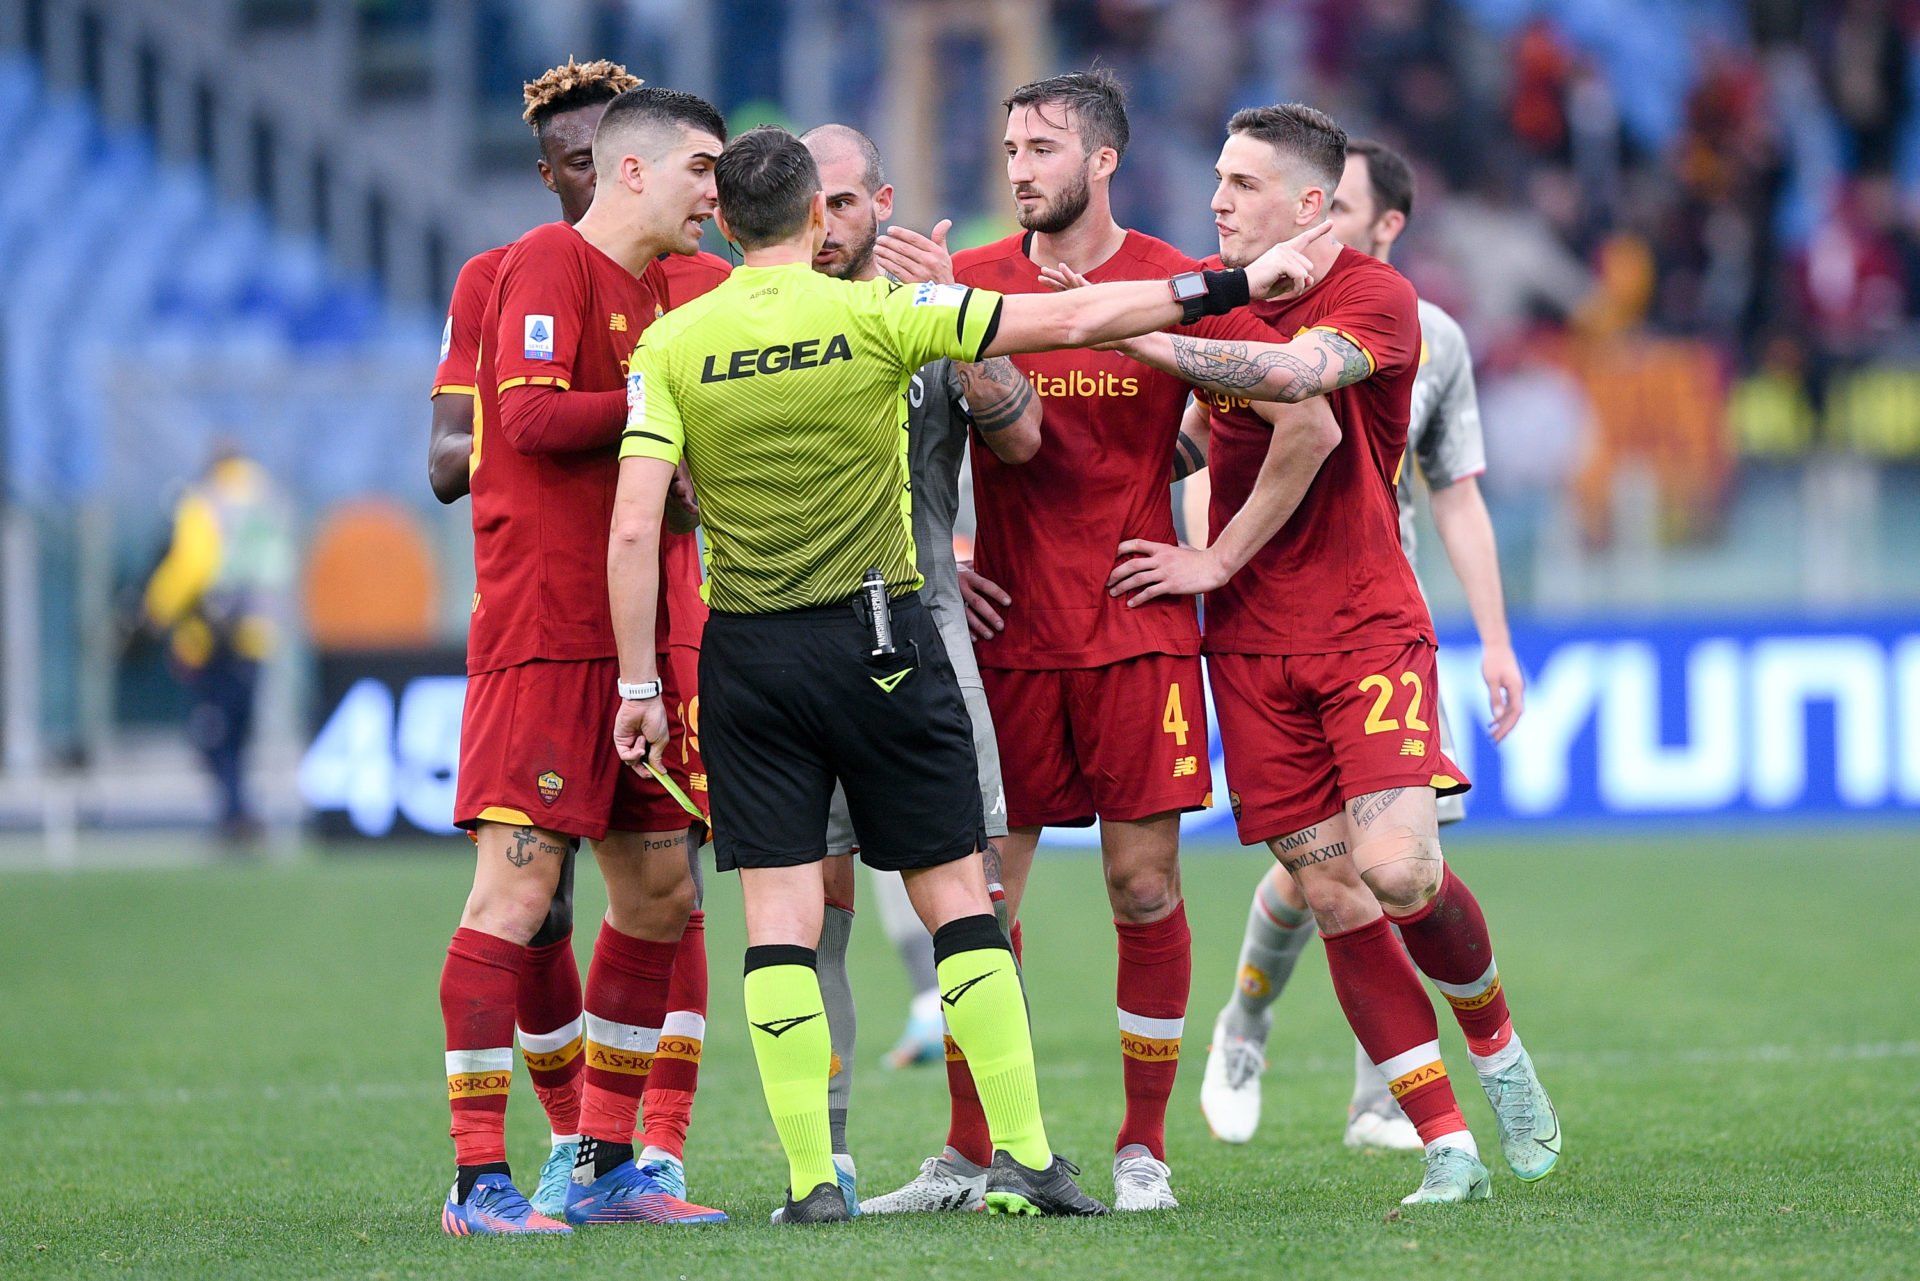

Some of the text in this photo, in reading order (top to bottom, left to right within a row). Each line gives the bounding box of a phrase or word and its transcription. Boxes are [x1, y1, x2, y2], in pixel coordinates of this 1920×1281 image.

[700, 333, 853, 384] LEGEA
[1162, 683, 1189, 746] 4
[1358, 671, 1430, 736] 22
[644, 839, 672, 851] Para
[1278, 827, 1318, 853] MMIV
